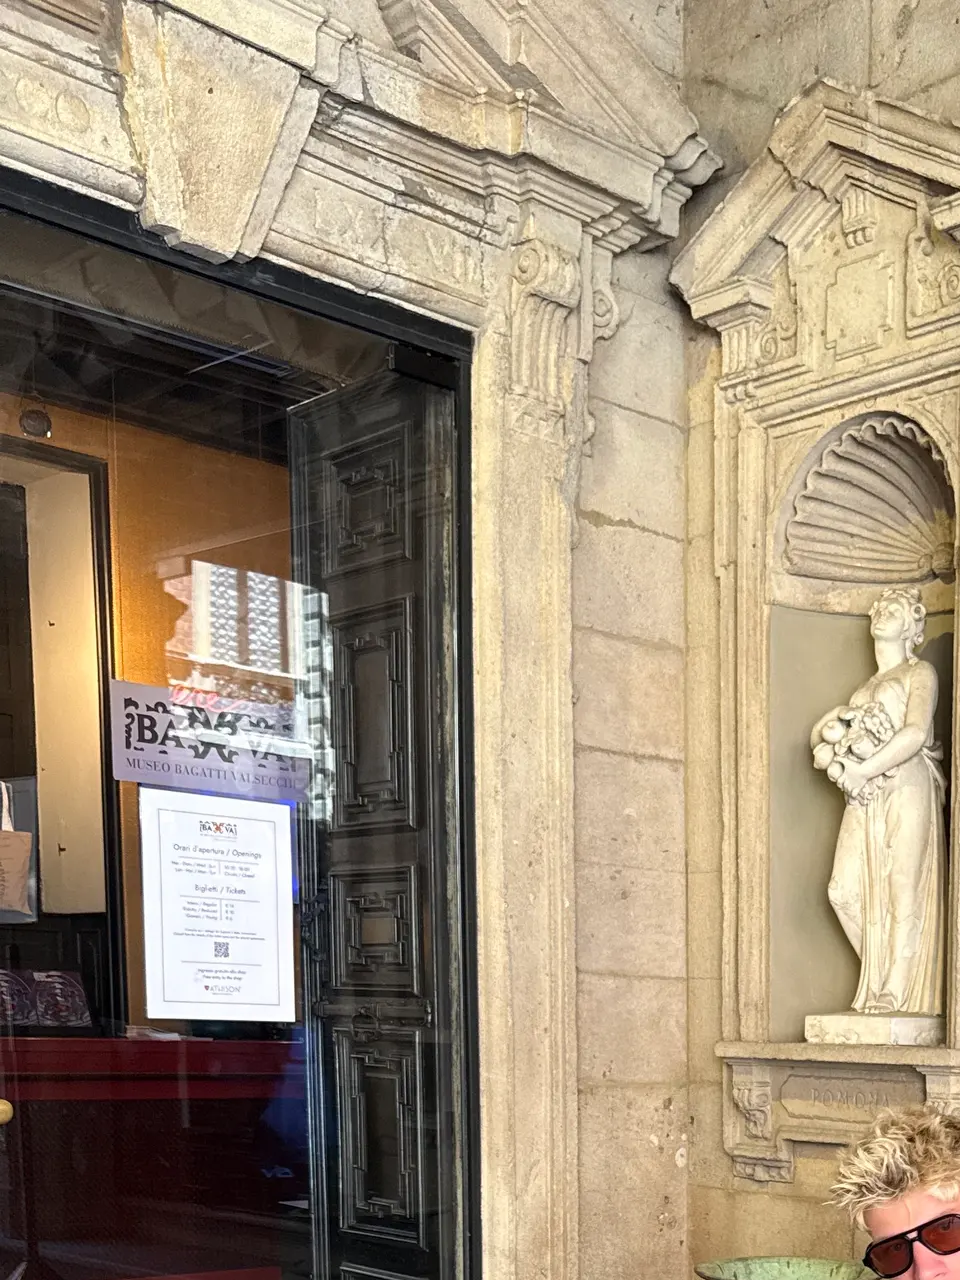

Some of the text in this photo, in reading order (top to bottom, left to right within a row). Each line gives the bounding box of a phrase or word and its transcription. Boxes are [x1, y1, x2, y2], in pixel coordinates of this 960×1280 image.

[125, 757, 171, 773] MUSEO
[174, 764, 227, 781] BAGATTI
[173, 843, 191, 852] Orari
[231, 849, 262, 860] Openings
[225, 886, 246, 895] Tickets
[811, 1086, 889, 1110] POMONA
